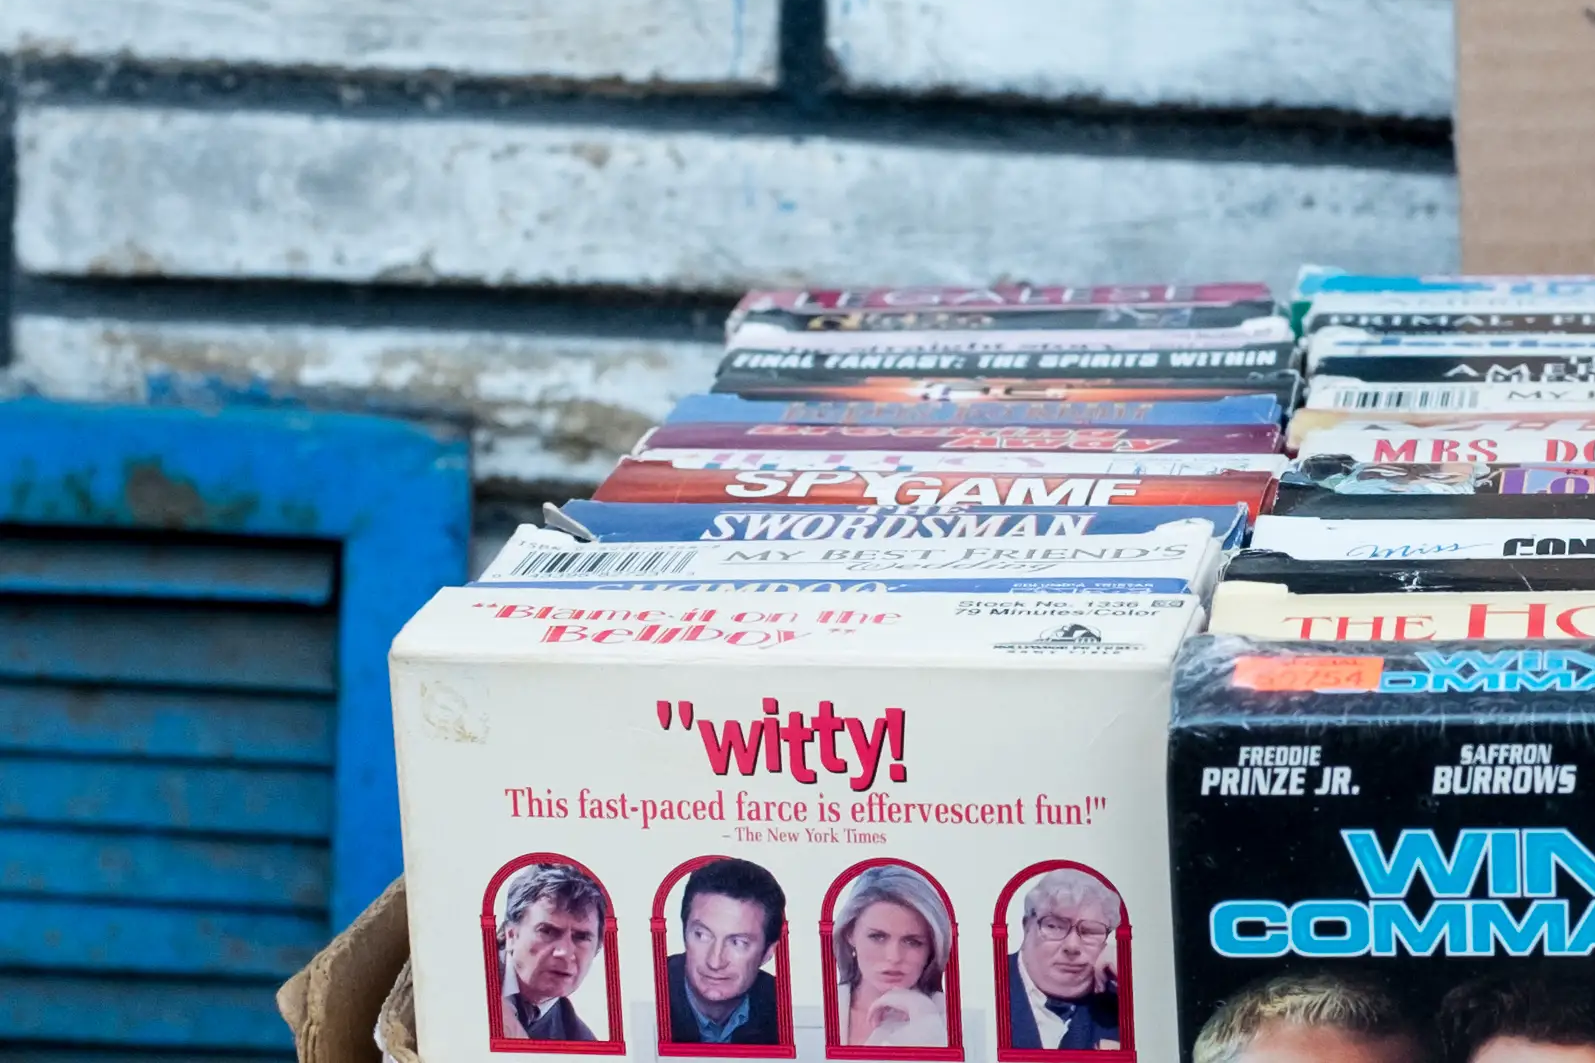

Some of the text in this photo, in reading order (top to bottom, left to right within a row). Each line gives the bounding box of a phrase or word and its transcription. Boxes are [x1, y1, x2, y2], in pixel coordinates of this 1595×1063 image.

[1329, 314, 1514, 327] PRIMAL
[732, 349, 1278, 370] FINAL FANTASY: THE SPIRITS WITHIN
[1506, 390, 1563, 400] MY
[1373, 438, 1499, 463] MRS
[724, 469, 1142, 507] SPY GAME
[855, 504, 967, 516] THE
[699, 512, 1098, 541] SWORDSMAN
[724, 543, 1190, 562] MY BEST FRIEND'S
[842, 559, 1059, 574] Wedding
[954, 607, 982, 617] 79
[957, 599, 1029, 608] Stock
[1034, 599, 1073, 608] No.
[1086, 599, 1140, 608] 1336
[730, 611, 799, 624] on
[816, 609, 903, 626] the
[1281, 614, 1438, 642] THE
[655, 696, 909, 794] "witty!
[1459, 743, 1553, 766] SAFFRON
[1237, 745, 1322, 767] FREDDIE
[1200, 766, 1361, 796] PRINZE JR.
[1431, 765, 1578, 795] BURROWS
[504, 788, 1108, 830] This fast-paced farce is effervescent fun!"
[734, 827, 888, 847] The New York Times
